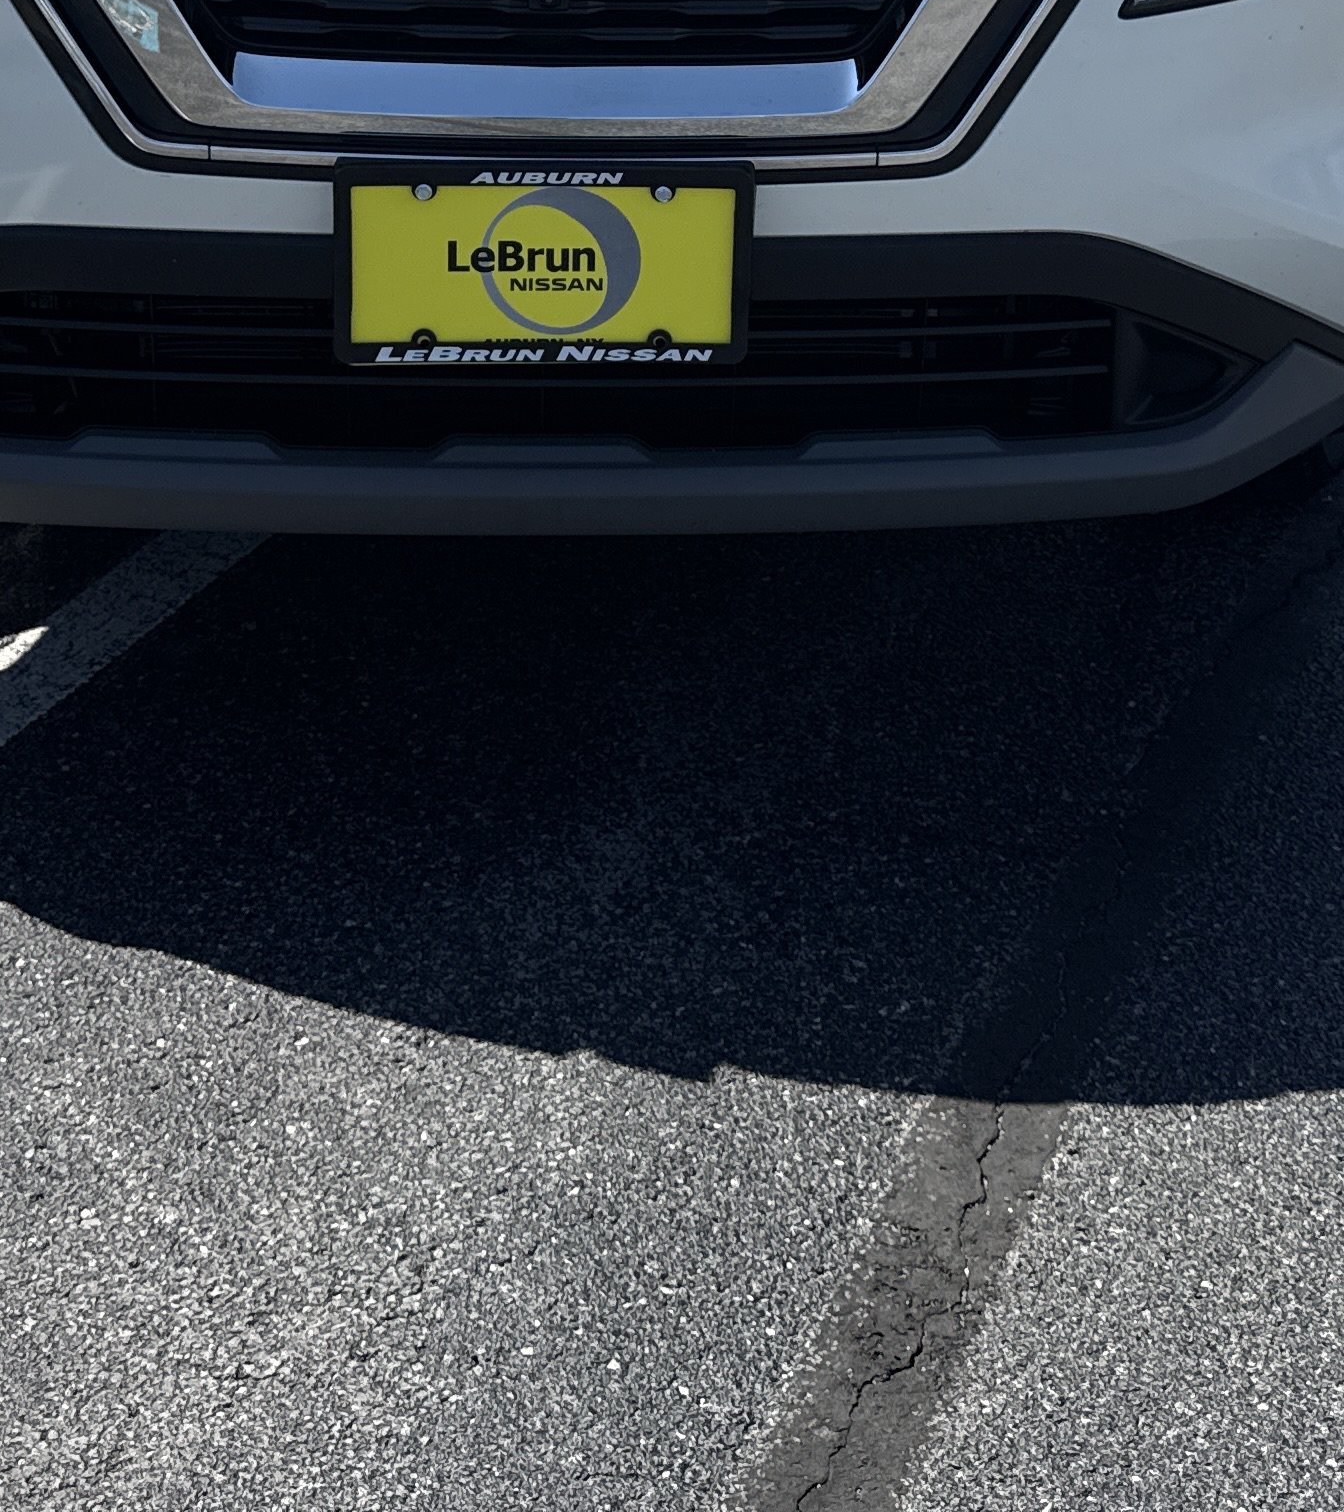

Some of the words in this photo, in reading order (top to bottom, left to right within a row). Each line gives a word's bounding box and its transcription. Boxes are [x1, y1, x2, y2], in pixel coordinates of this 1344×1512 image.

[470, 171, 625, 185] AUBURN
[447, 240, 596, 273] LeBrun
[509, 278, 603, 291] NISSAN
[556, 346, 713, 363] NISSAN
